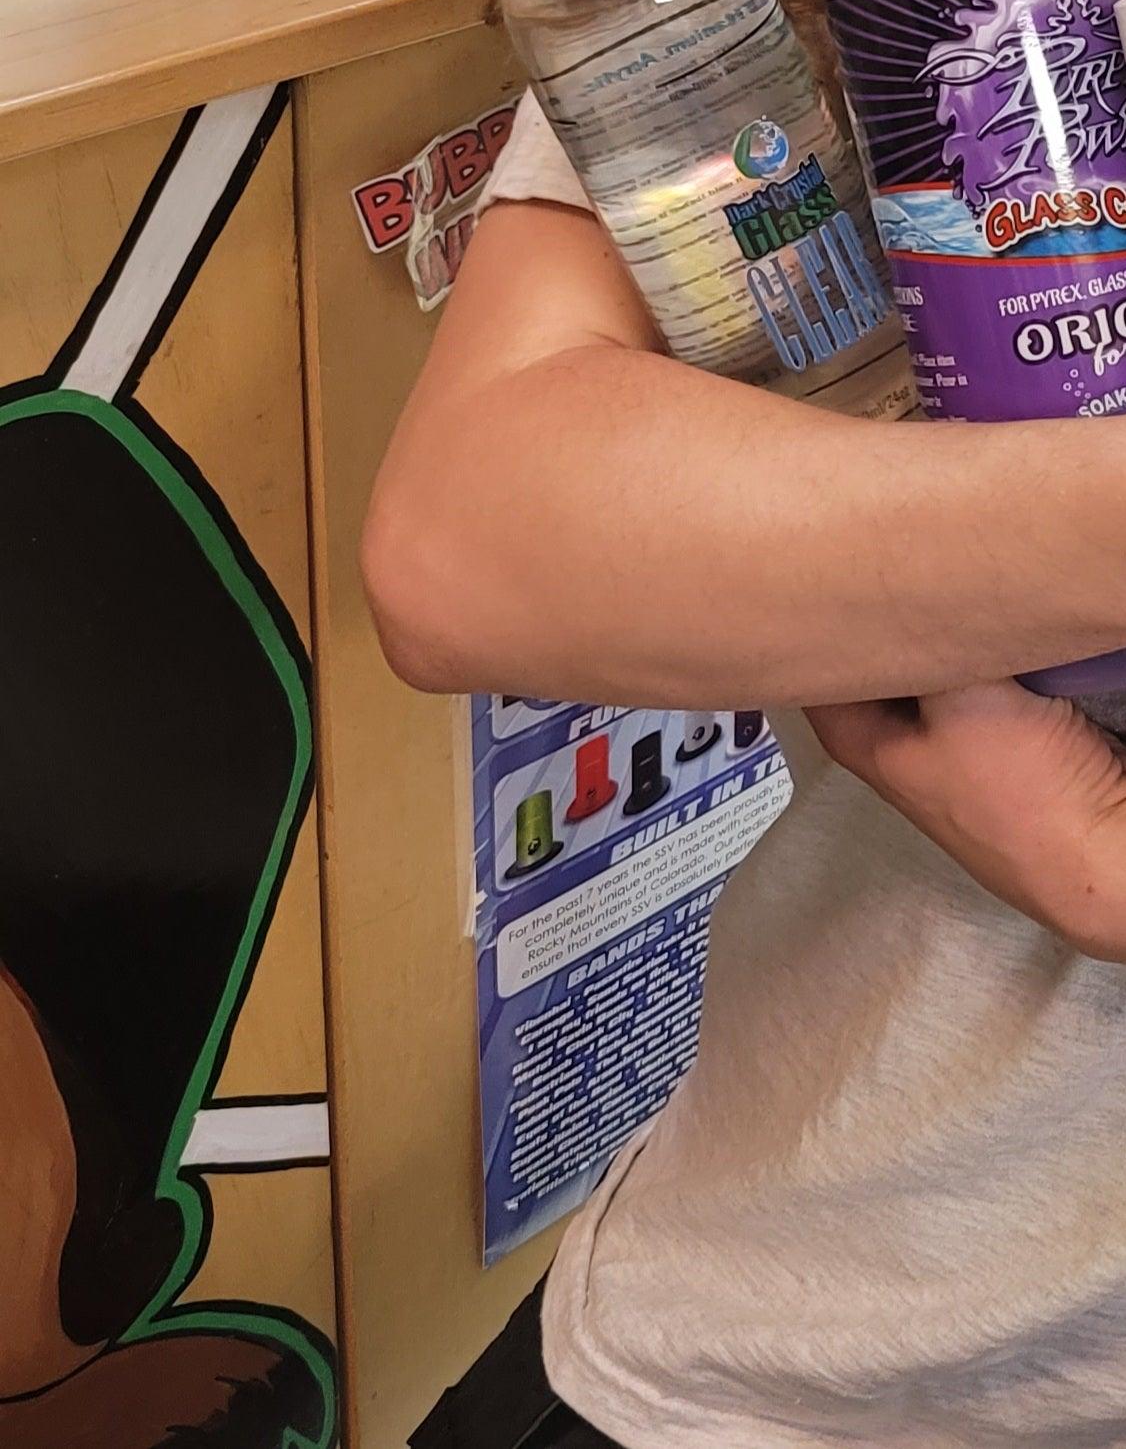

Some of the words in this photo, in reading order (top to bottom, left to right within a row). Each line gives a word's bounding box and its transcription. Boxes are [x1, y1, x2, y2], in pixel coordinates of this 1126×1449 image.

[727, 192, 771, 224] Dark
[735, 184, 837, 259] Glass
[986, 191, 1101, 249] GLASS
[747, 210, 888, 373] CLEAR
[998, 291, 1029, 317] FOR
[508, 923, 530, 943] For
[532, 911, 553, 931] the
[555, 893, 584, 919] past
[586, 886, 595, 901] 7
[596, 870, 629, 895] years
[632, 857, 652, 873] the
[653, 842, 679, 861] SSV
[678, 832, 699, 850] has
[701, 811, 732, 836] been
[733, 782, 776, 818] proudly
[611, 796, 704, 865] BUILT
[710, 773, 744, 807] IN
[524, 902, 598, 948] completely
[599, 875, 643, 908] unique
[643, 859, 669, 881] and
[680, 837, 717, 862] made
[717, 819, 742, 840] with
[743, 805, 770, 825] care
[770, 793, 787, 813] by
[527, 931, 567, 963] Rocky
[569, 894, 633, 935] Mountains
[634, 884, 649, 902] of
[649, 854, 706, 892] Colorado.
[714, 837, 734, 853] Our
[520, 950, 564, 980] ensure
[566, 932, 593, 956] that
[594, 914, 630, 939] every
[630, 898, 654, 918] SSV
[665, 859, 723, 897] absolutely
[567, 917, 667, 989] BANDS
